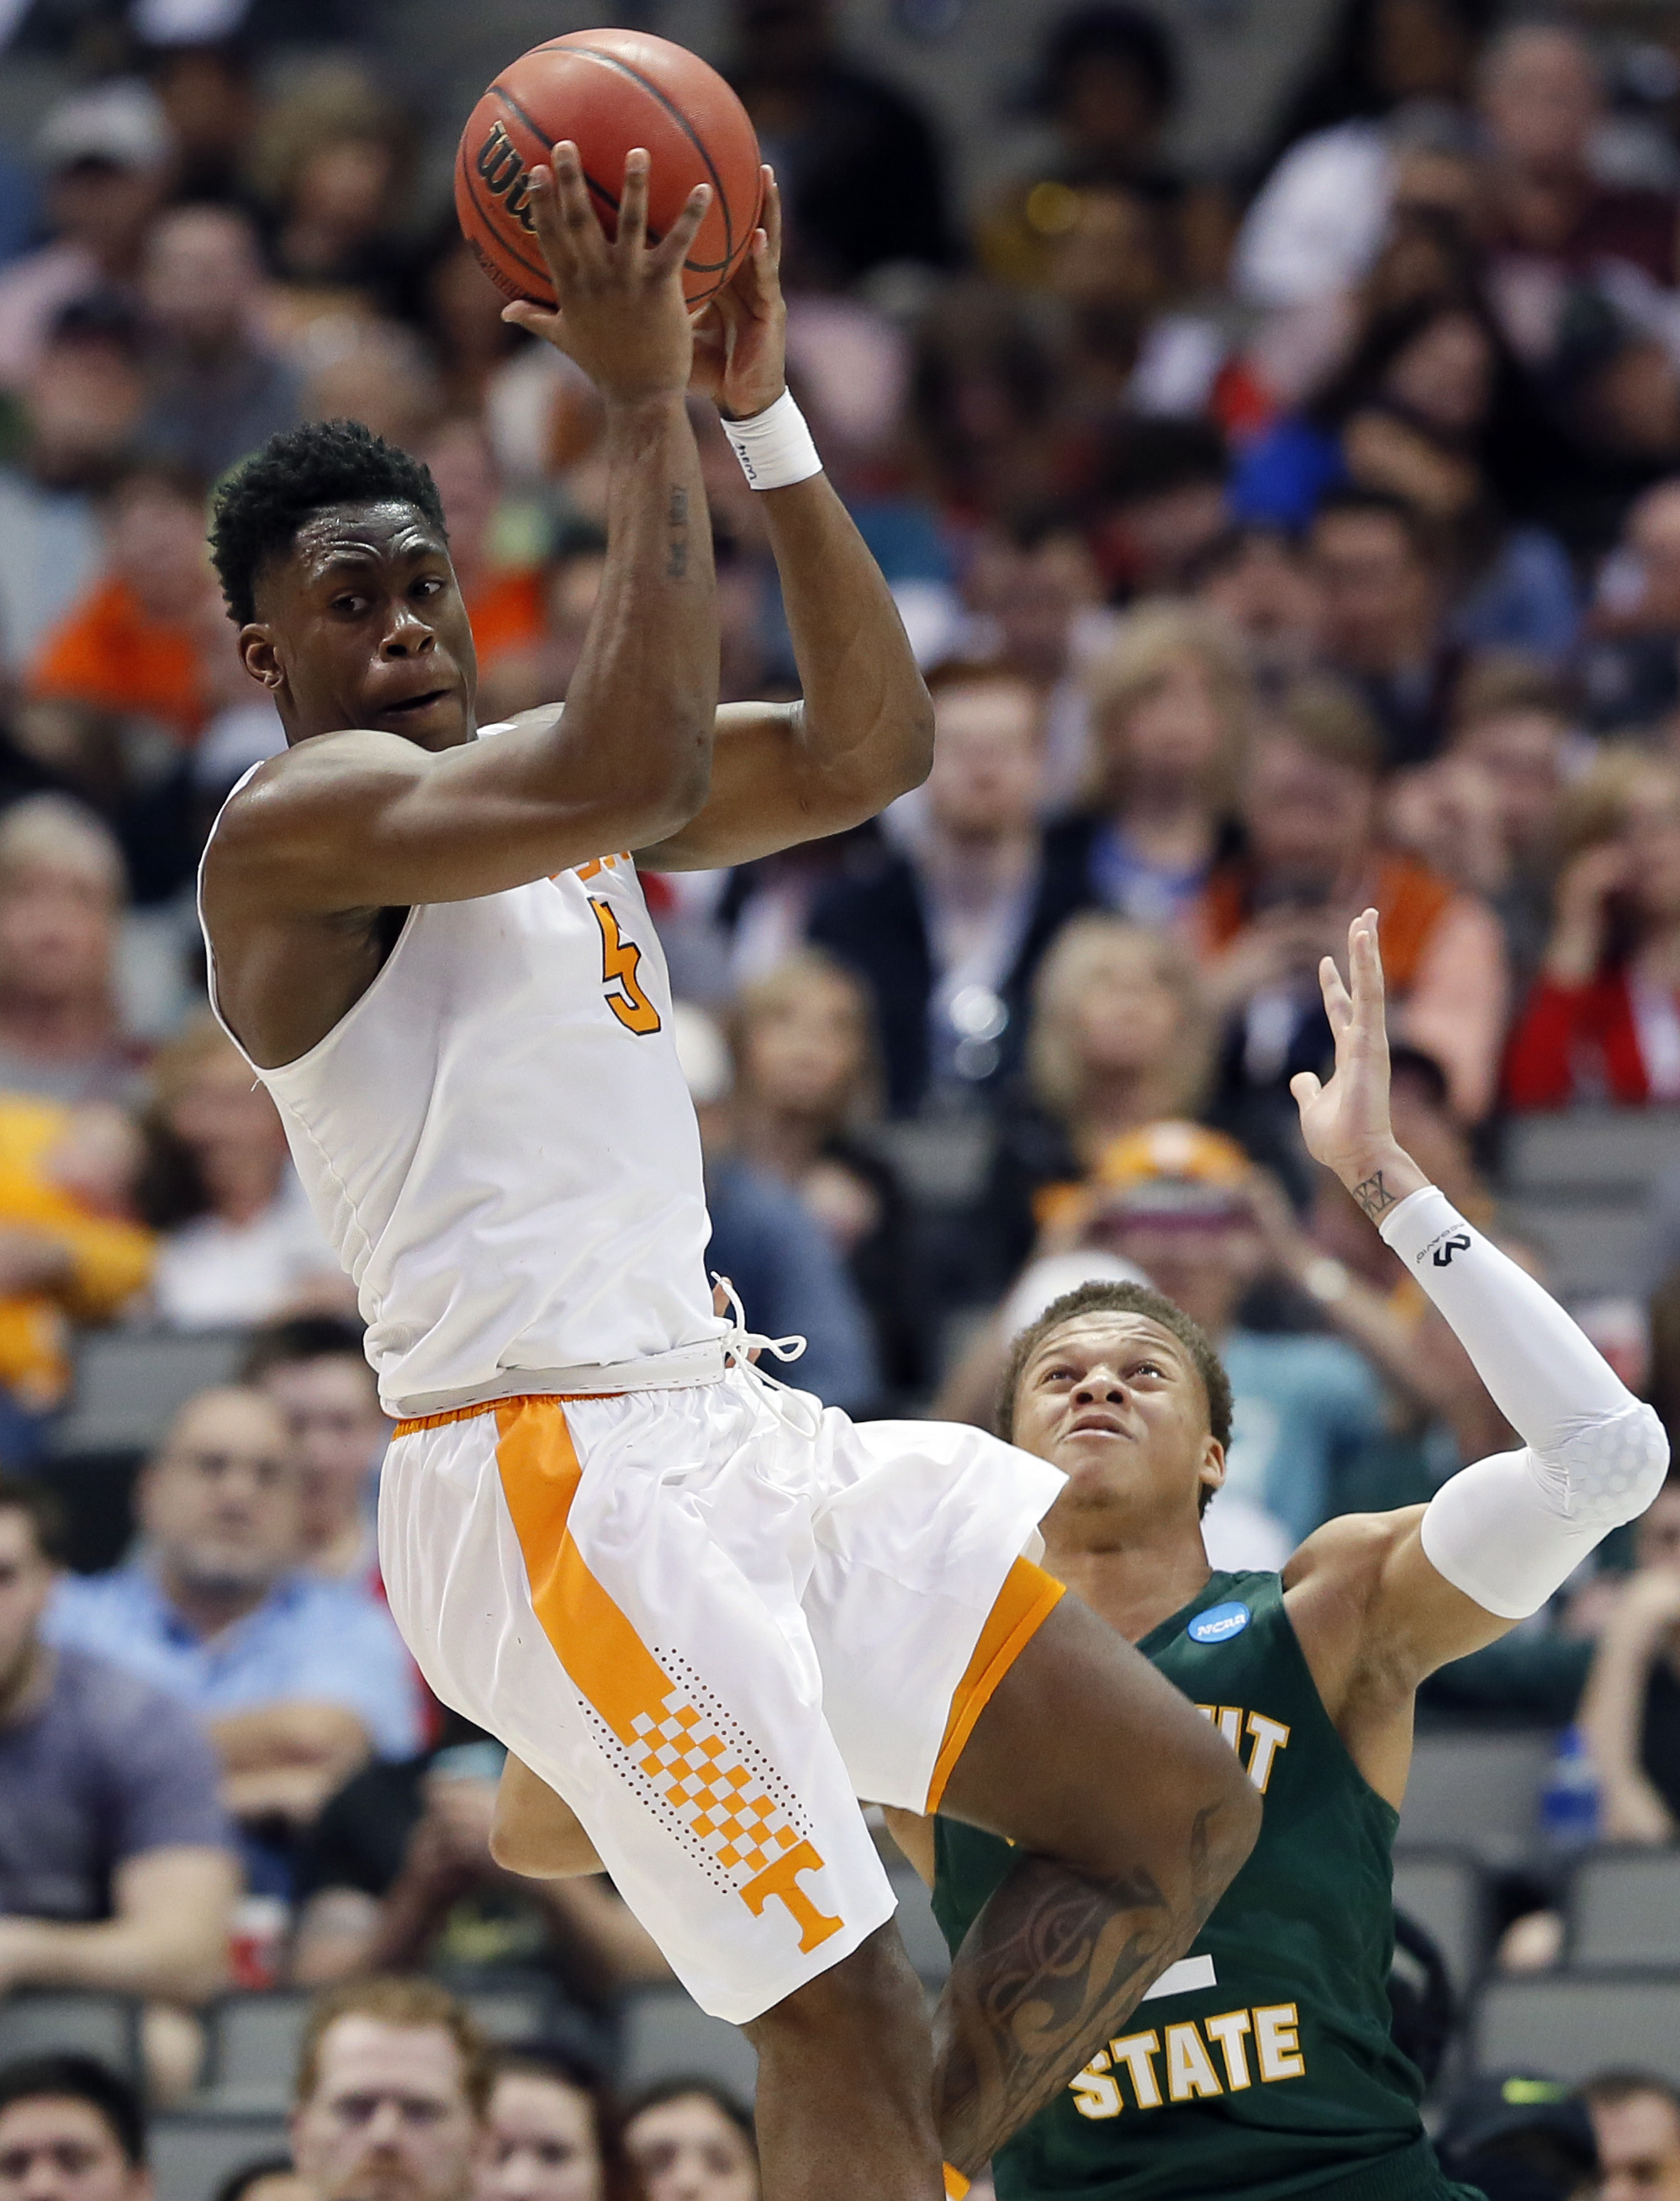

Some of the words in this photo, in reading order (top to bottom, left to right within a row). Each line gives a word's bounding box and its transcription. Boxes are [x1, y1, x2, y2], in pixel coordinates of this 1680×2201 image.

[586, 896, 662, 1037] 5
[1197, 1612, 1248, 1638] NCAA
[737, 1839, 846, 1955] T
[1068, 2002, 1306, 2119] STATE
